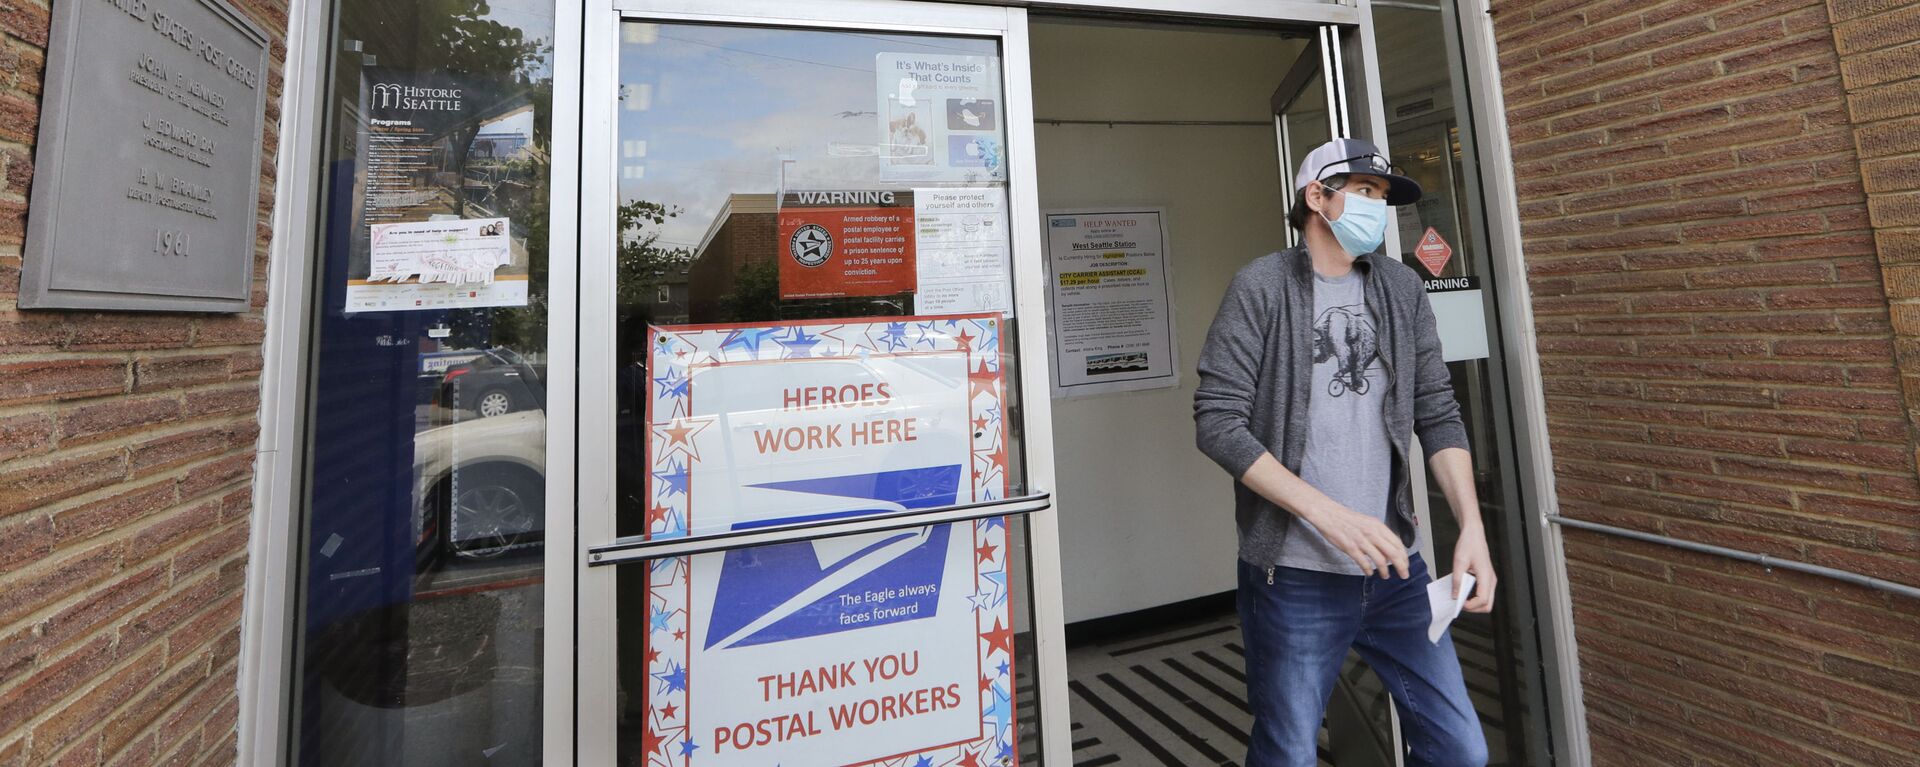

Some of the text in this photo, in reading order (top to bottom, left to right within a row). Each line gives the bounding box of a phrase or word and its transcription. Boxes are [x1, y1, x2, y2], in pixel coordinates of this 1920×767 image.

[152, 10, 193, 50] STATES
[196, 38, 225, 69] POST
[226, 56, 256, 90] OFFICE
[896, 60, 982, 73] It's What's Inside
[138, 52, 168, 80] JOHN
[186, 80, 227, 110] KENNEDY
[908, 72, 971, 83] That Counts
[404, 86, 462, 99] HISTORIC
[402, 97, 461, 111] SEATTLE
[371, 118, 411, 127] Programs
[157, 118, 198, 148] EDWARD
[200, 136, 217, 155] DAY
[798, 191, 895, 205] WARNING
[959, 194, 985, 202] protect
[925, 202, 955, 210] yourself
[865, 215, 888, 223] robbery
[1083, 220, 1104, 228] HELP
[1104, 219, 1137, 227] WANTED
[843, 226, 862, 234] postal
[863, 226, 892, 234] employee
[153, 228, 190, 257] 1961
[843, 237, 862, 245] postal
[863, 236, 883, 244] facility
[1090, 241, 1113, 249] Seattle
[1114, 240, 1137, 248] Station
[849, 247, 869, 255] prison
[870, 258, 887, 266] years
[1098, 269, 1126, 277] ASSISTANT
[1424, 277, 1470, 290] ARNING
[783, 382, 892, 412] HEROES
[753, 418, 918, 454] WORK HERE
[838, 583, 936, 606] The Eagle always
[839, 602, 918, 625] faces forward
[757, 650, 919, 702] THANK YOU
[714, 683, 962, 754] POSTAL WORKERS
